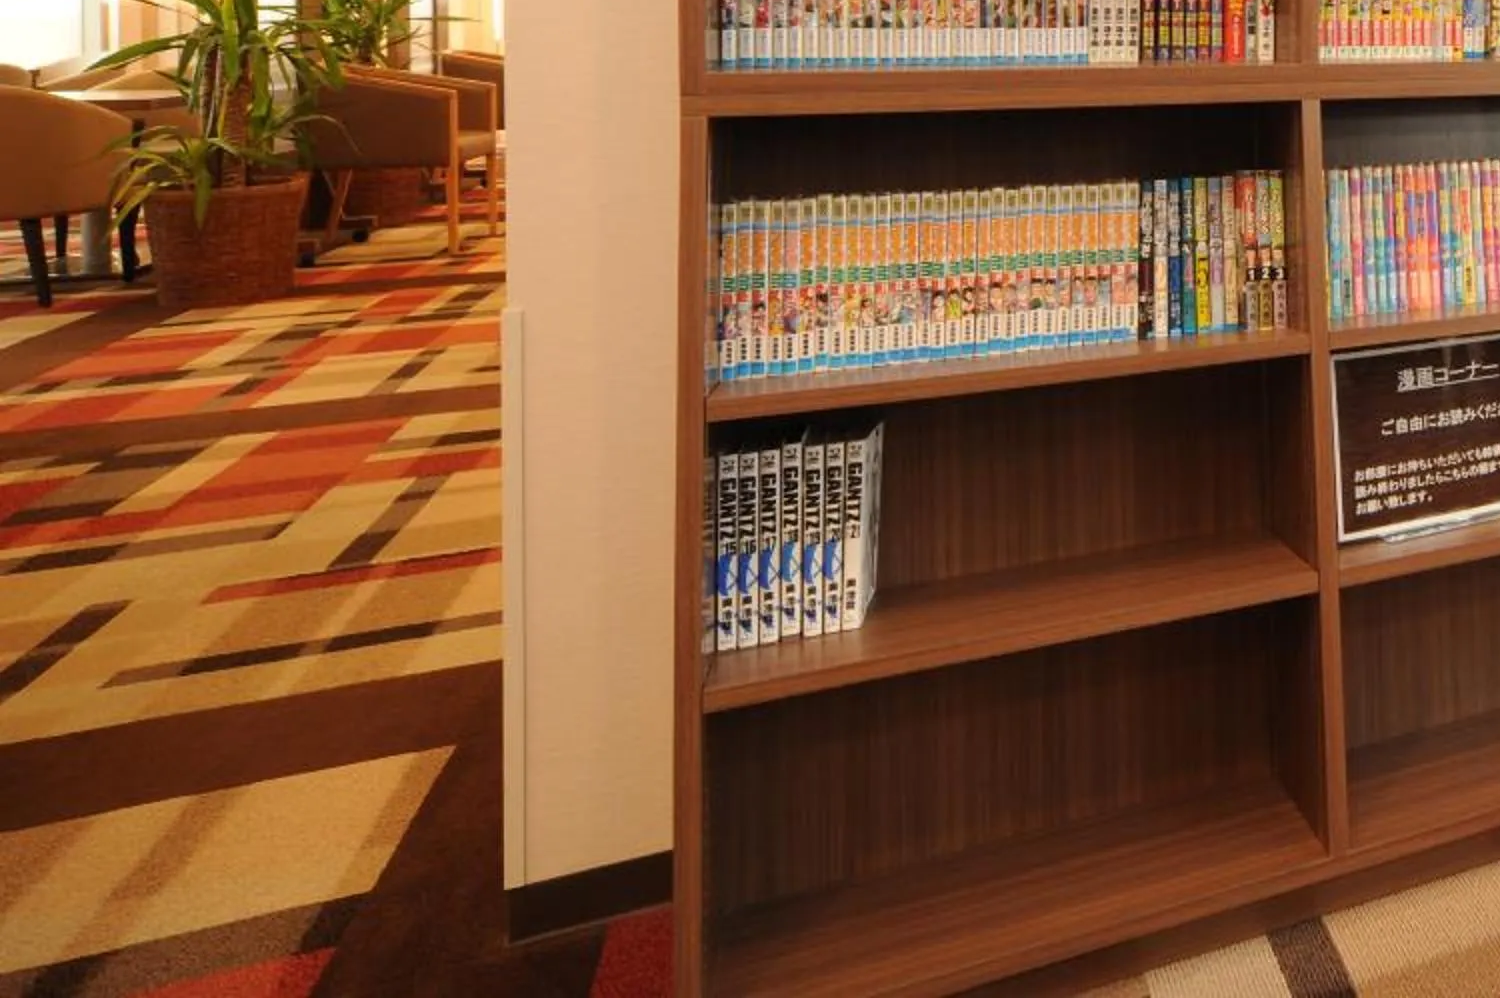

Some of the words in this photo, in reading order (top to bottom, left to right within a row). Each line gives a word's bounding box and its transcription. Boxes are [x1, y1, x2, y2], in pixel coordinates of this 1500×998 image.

[1397, 359, 1500, 392] 漫画コーナー
[720, 477, 737, 540] GANTZ
[740, 476, 756, 539] GANTZ
[761, 473, 777, 535] GANTZ
[783, 467, 799, 528] GANTZ
[806, 468, 820, 531] GANTZ
[827, 466, 841, 526] GANTZ
[847, 462, 862, 521] GANTZ
